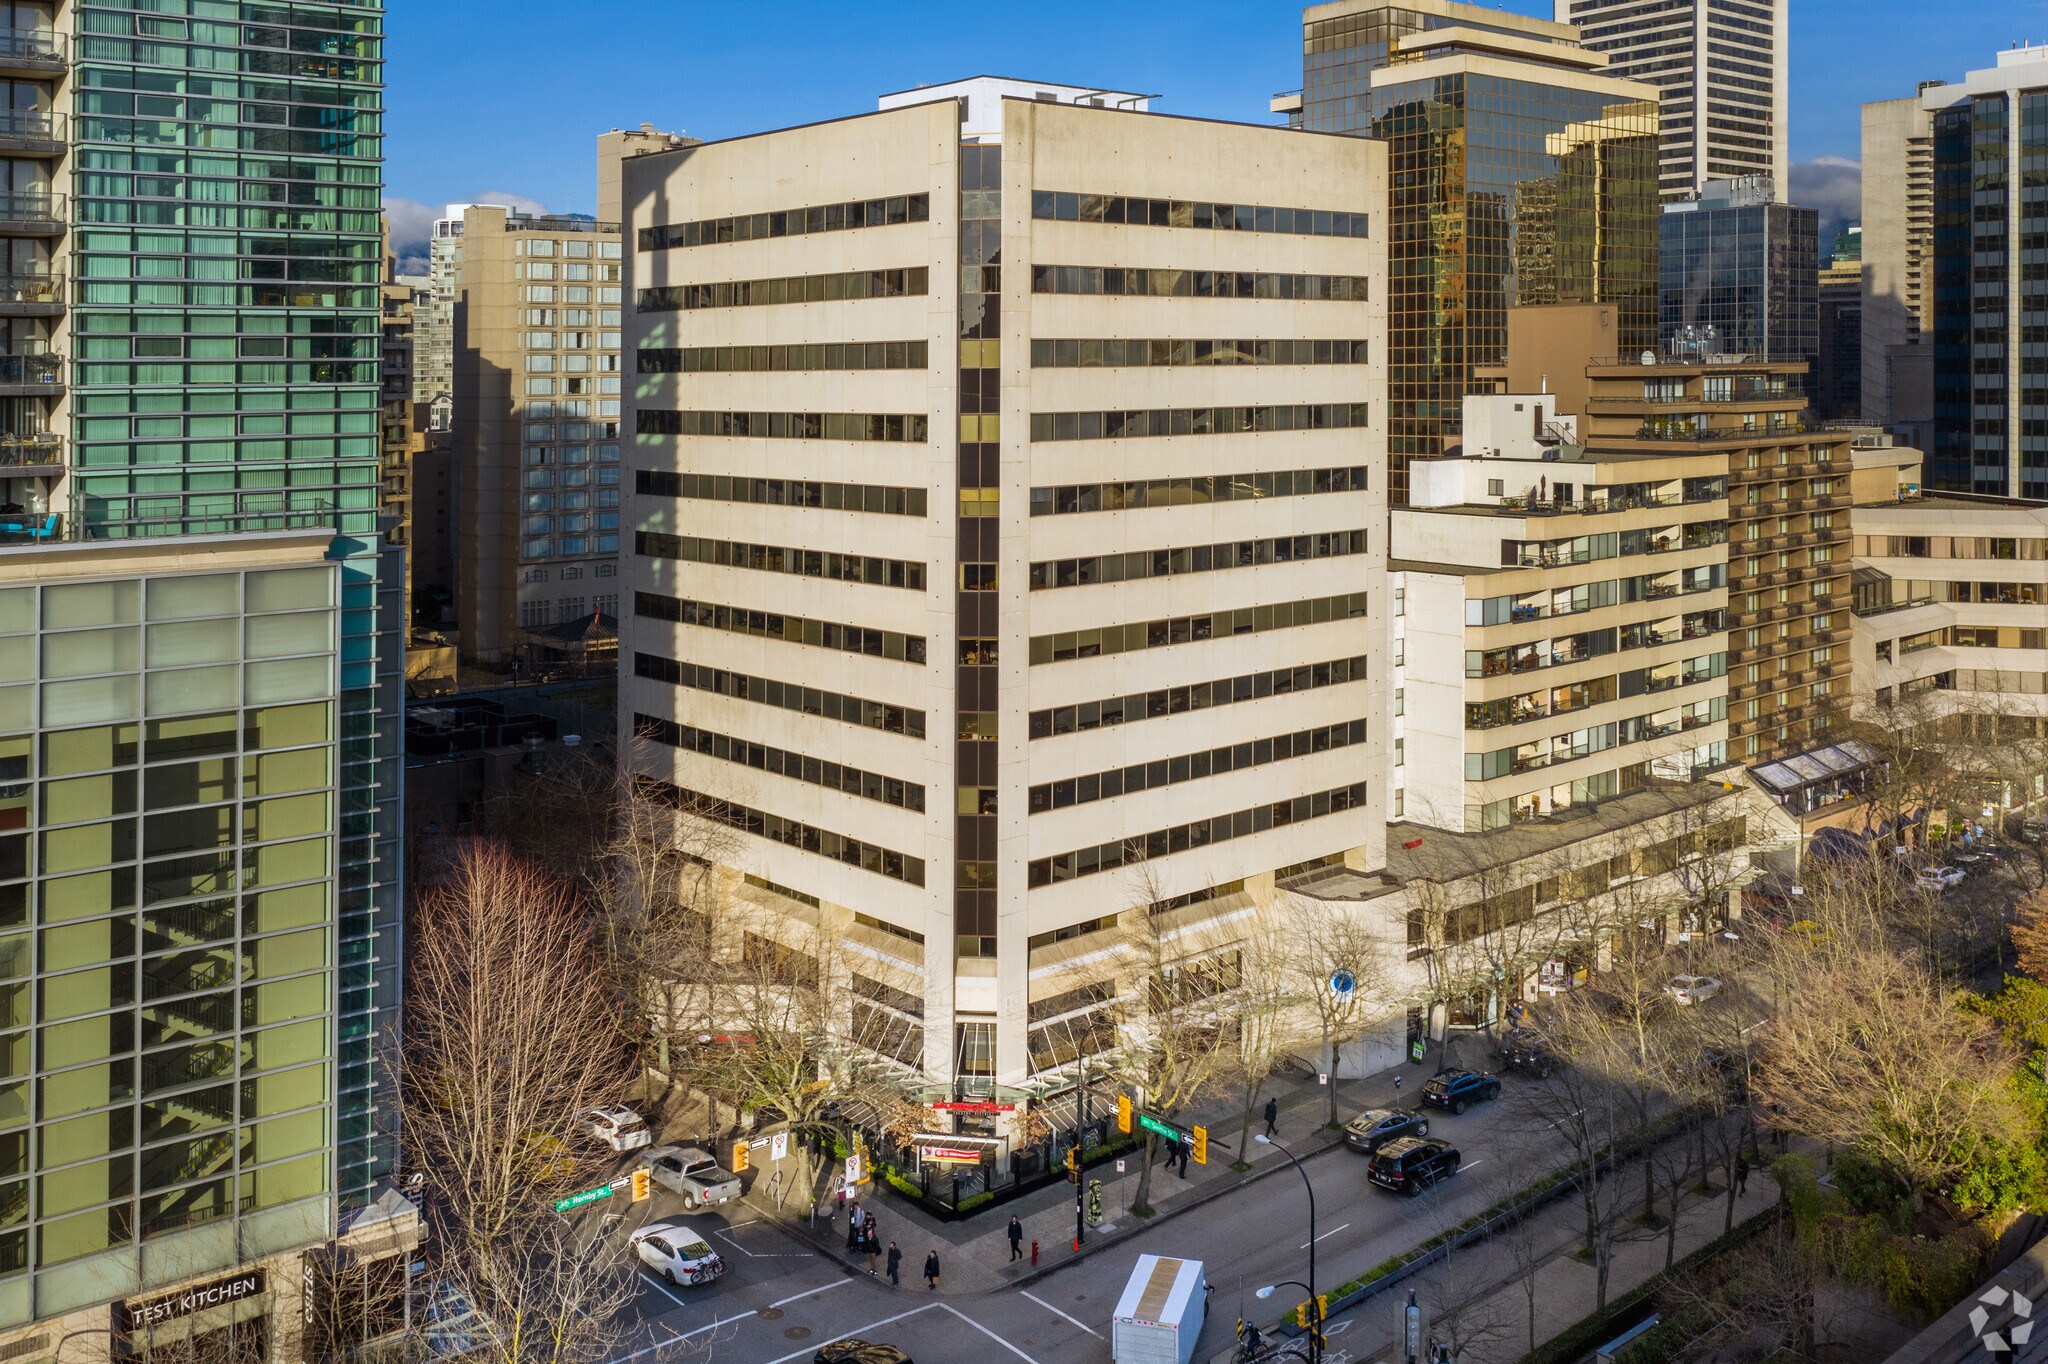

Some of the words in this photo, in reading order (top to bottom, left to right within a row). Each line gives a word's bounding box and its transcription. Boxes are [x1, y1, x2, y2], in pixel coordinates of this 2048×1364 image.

[932, 1099, 979, 1111] Boston
[980, 1101, 1015, 1112] Pizza
[572, 1191, 597, 1204] Hornby
[133, 1301, 172, 1324] TEST
[180, 1277, 255, 1311] KITCHEN
[304, 1264, 314, 1324] earls
